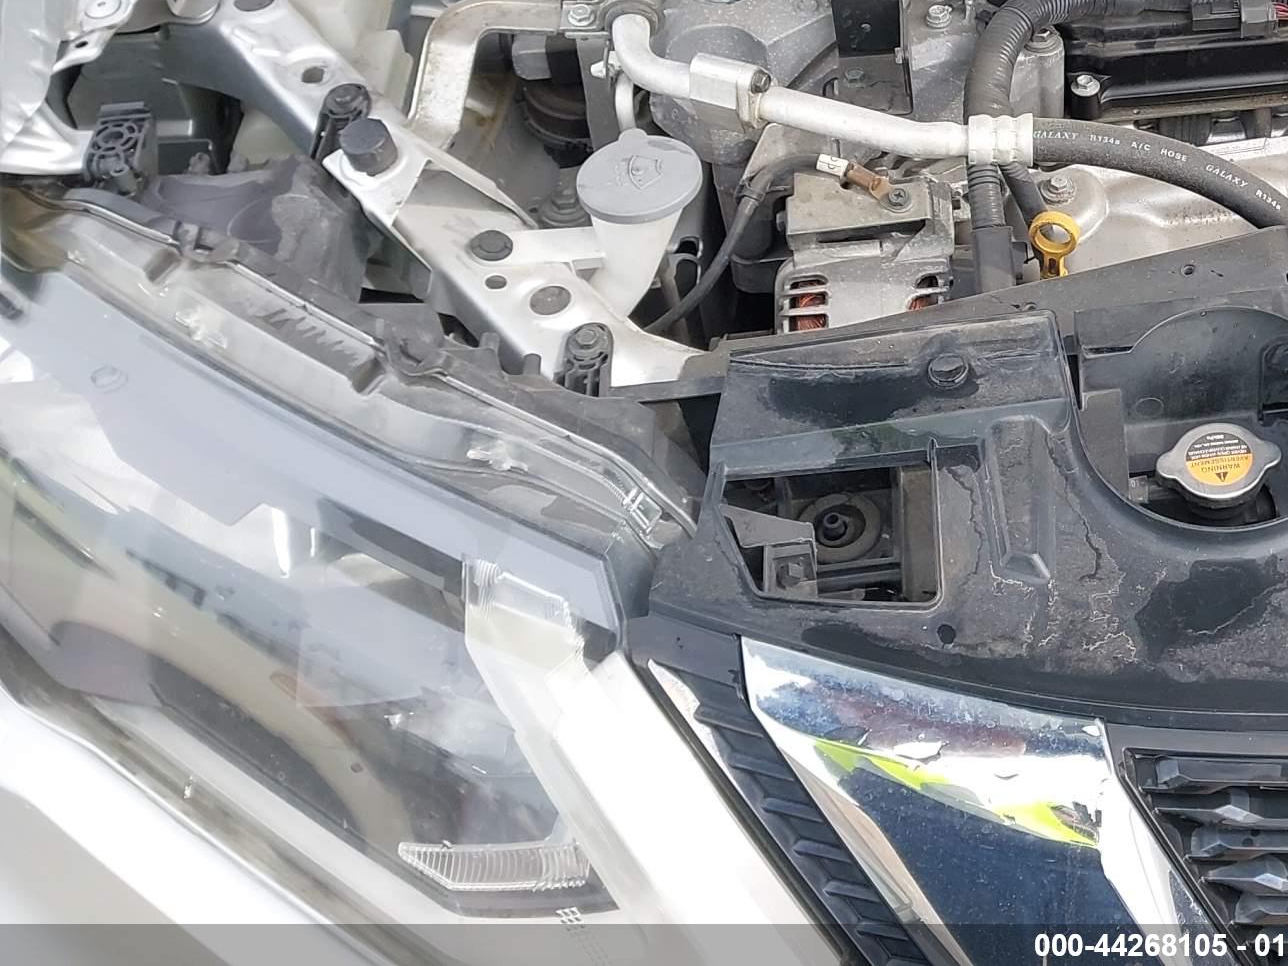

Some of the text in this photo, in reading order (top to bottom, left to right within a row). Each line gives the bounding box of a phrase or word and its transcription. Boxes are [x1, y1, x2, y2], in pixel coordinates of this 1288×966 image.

[1033, 129, 1080, 141] GALAXY
[1088, 133, 1121, 146] R134a
[1130, 139, 1152, 152] A/C
[1160, 147, 1189, 163] HOSE
[1205, 162, 1250, 189] GALAXY
[1191, 455, 1249, 468] AVERTISSEMENT
[1200, 463, 1241, 474] WARNING
